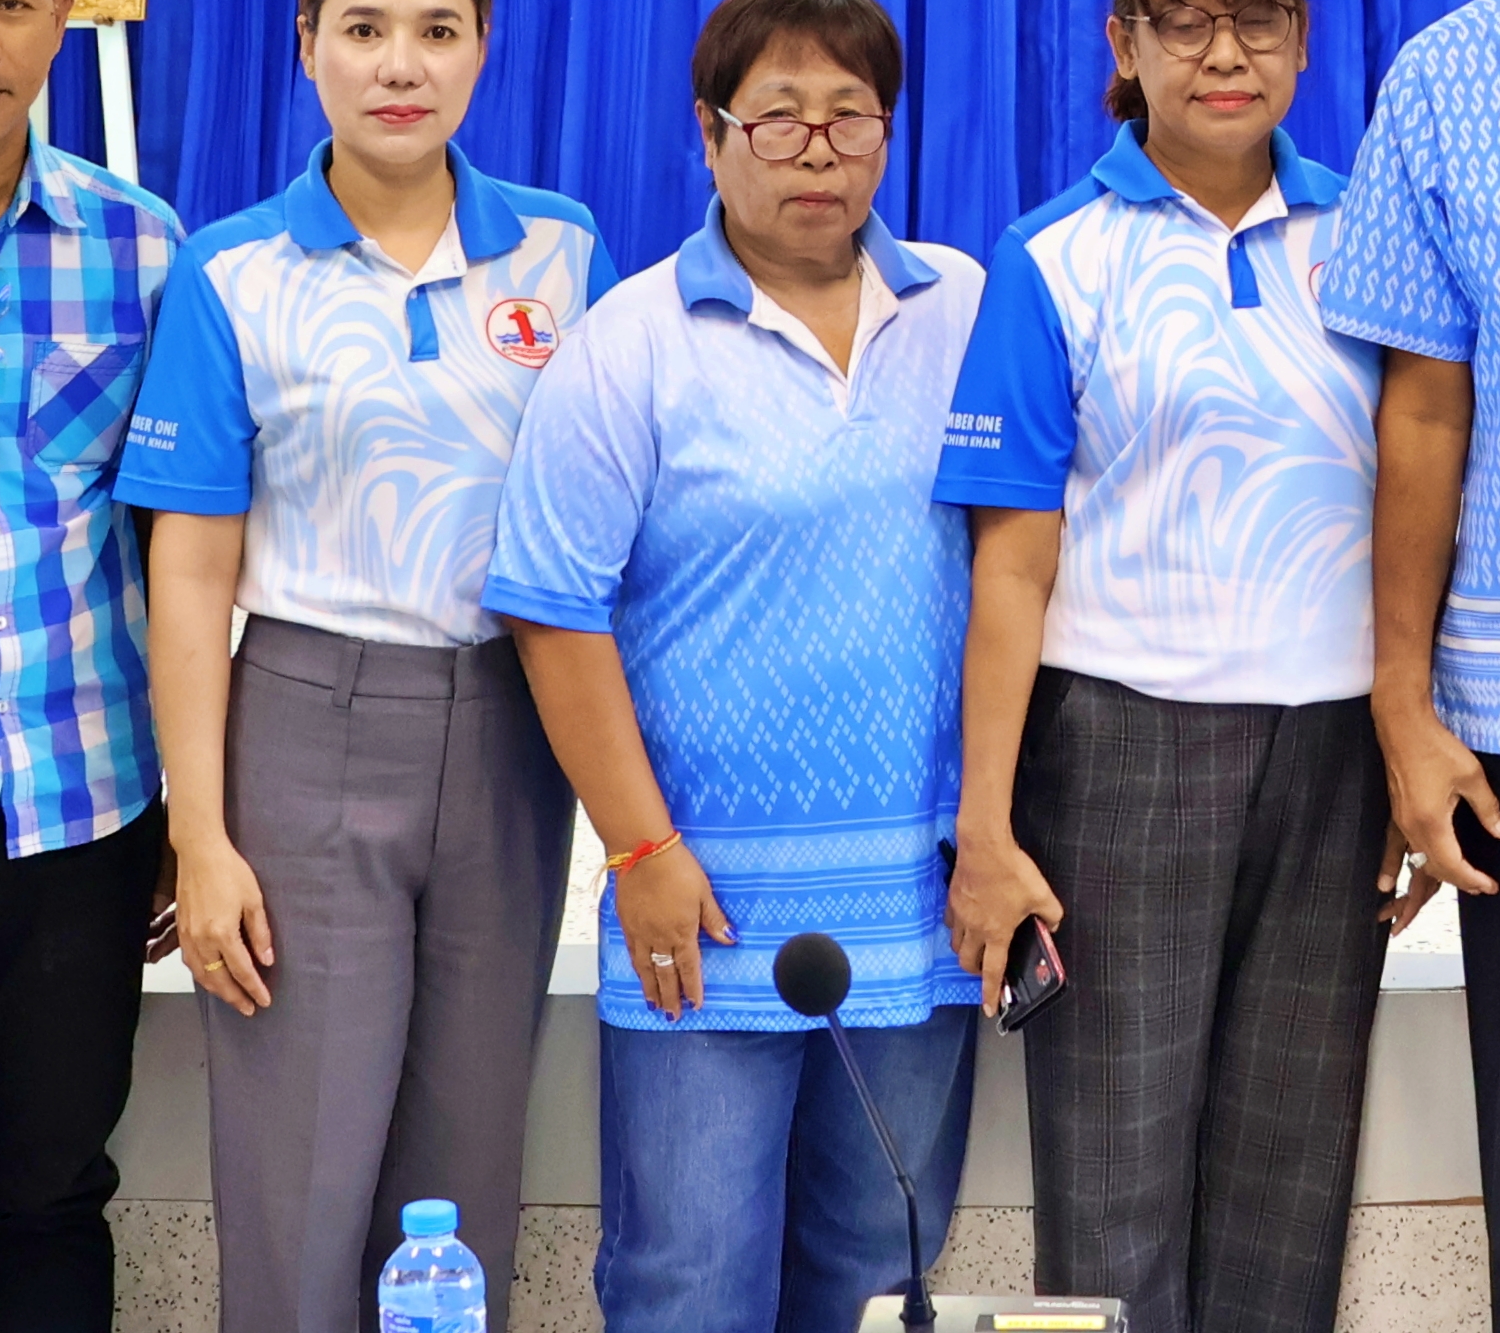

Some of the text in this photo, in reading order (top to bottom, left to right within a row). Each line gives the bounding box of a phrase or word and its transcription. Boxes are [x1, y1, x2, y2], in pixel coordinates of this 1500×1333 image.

[155, 420, 179, 437] ONE
[975, 415, 1003, 433] ONE
[148, 437, 175, 451] KHAN
[969, 436, 1001, 450] KHAN
